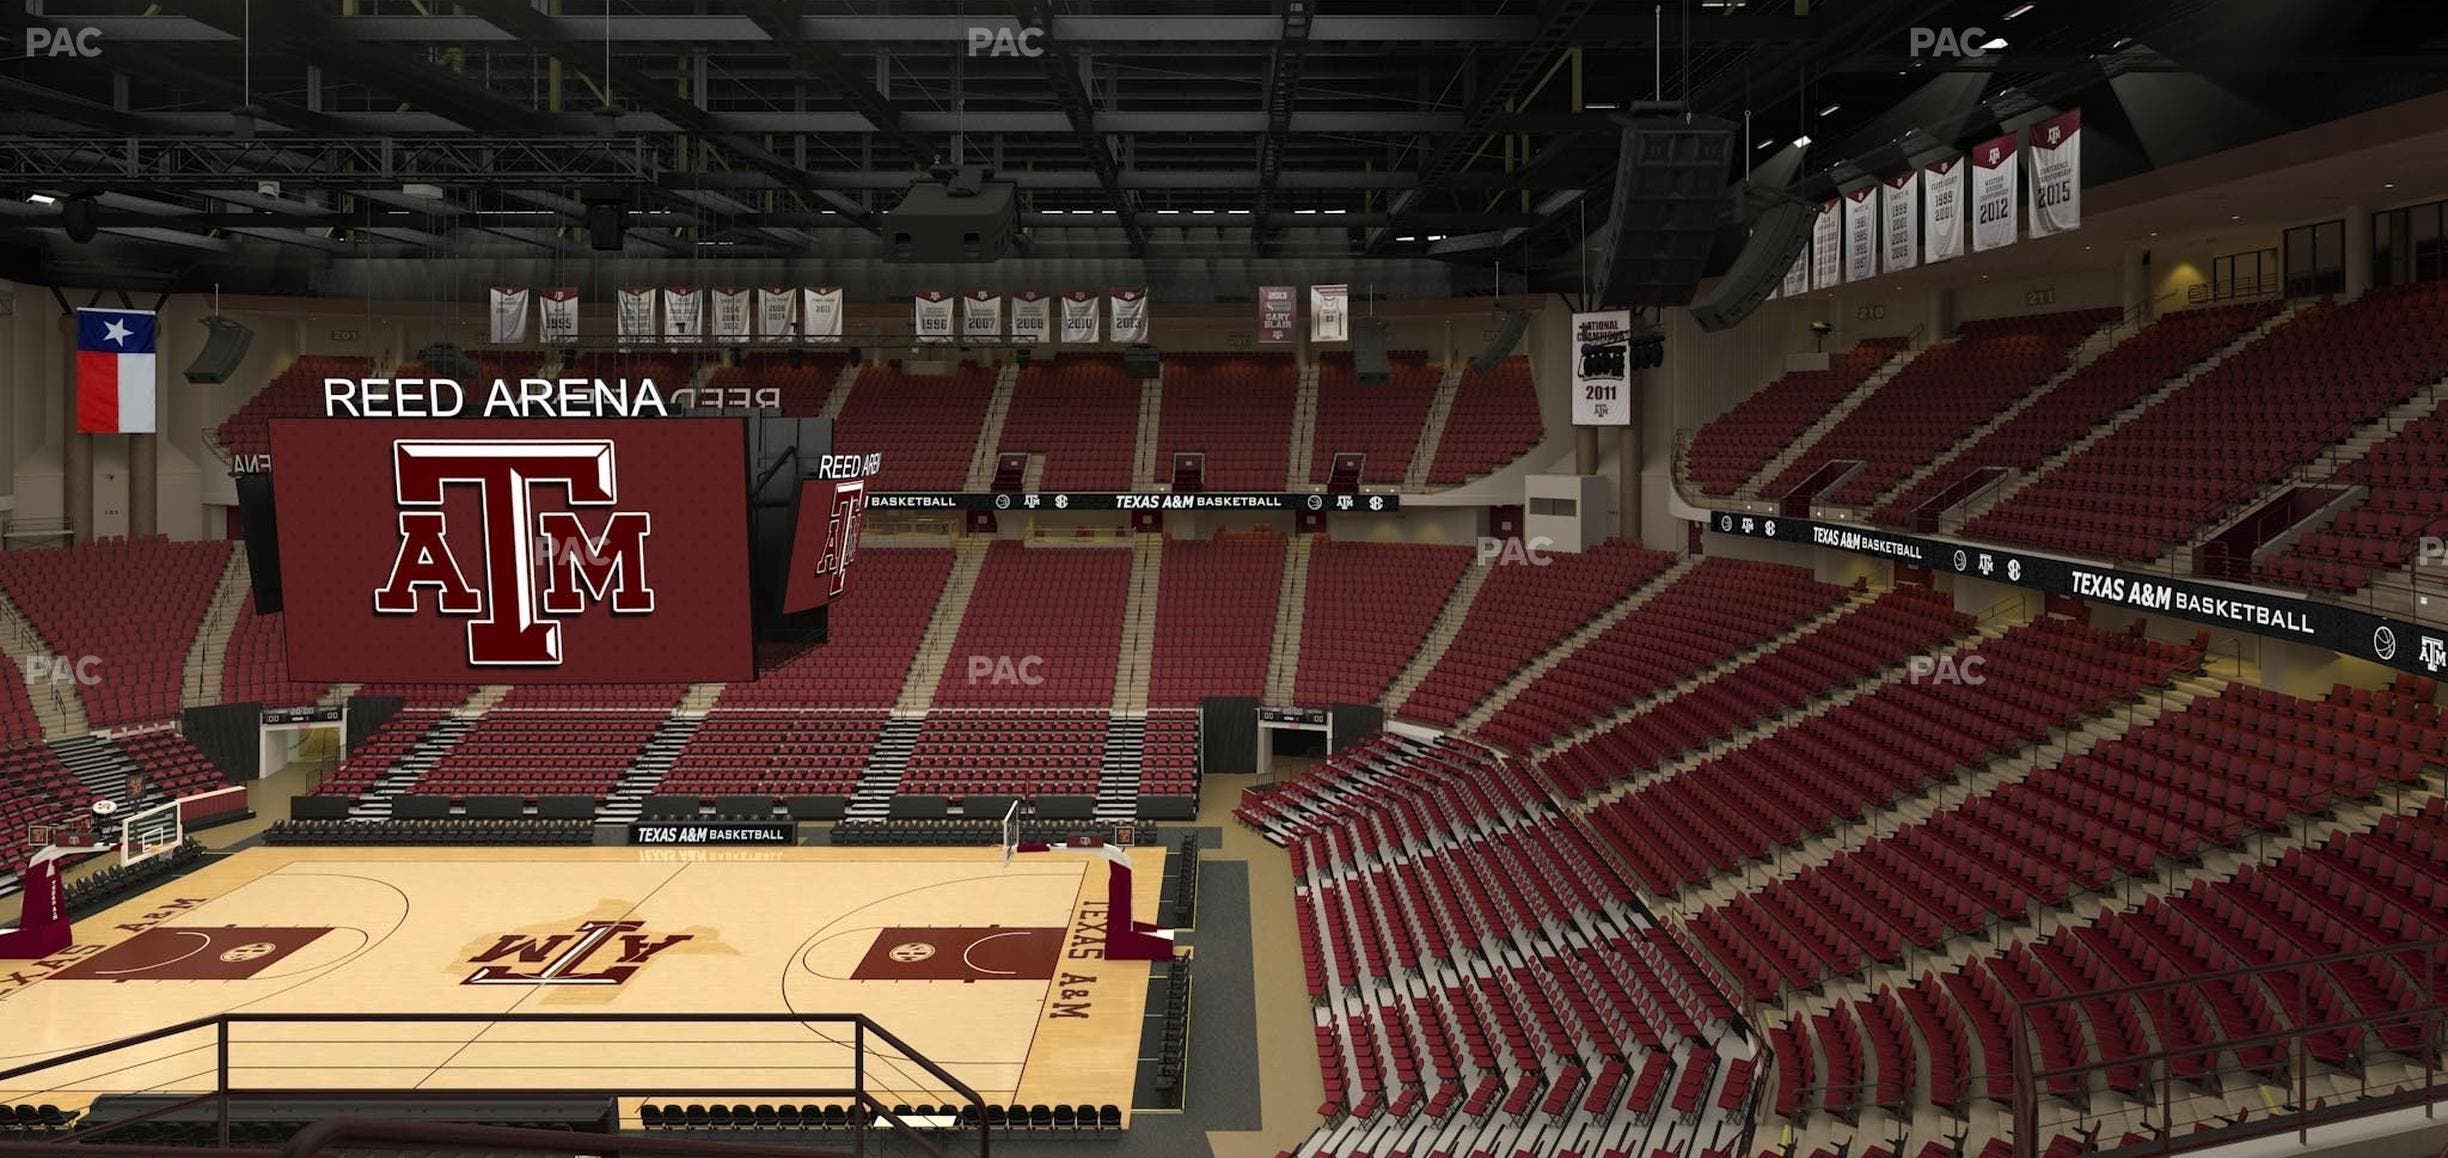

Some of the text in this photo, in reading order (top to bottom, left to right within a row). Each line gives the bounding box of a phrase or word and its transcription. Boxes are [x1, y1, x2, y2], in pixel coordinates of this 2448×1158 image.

[1935, 191, 1953, 207] 1999
[2038, 181, 2071, 209] 2015
[1935, 206, 1954, 222] 2001
[1980, 198, 2008, 225] 2012
[921, 319, 947, 329] 1996
[968, 318, 995, 329] 2007
[1067, 318, 1093, 329] 2010
[1116, 318, 1141, 329] 2013
[1264, 320, 1292, 329] BLAIR
[1265, 313, 1290, 321] GARY
[324, 378, 464, 417] REED
[483, 378, 669, 417] ARENA
[1586, 385, 1617, 400] 2011
[818, 454, 861, 480] REED
[871, 497, 956, 507] BASKETBALL
[1116, 495, 1282, 509] TEXAS A&M BASKETBALL
[1813, 526, 1923, 559] TEXAS A&M BASKETBALL
[2072, 570, 2315, 634] TEXAS A&M BASKETBALL
[637, 827, 784, 843] TEXAS A&M BASKETBALL
[0, 898, 210, 996] XAS A&M
[1050, 901, 1109, 1019] TEXAS A&M
